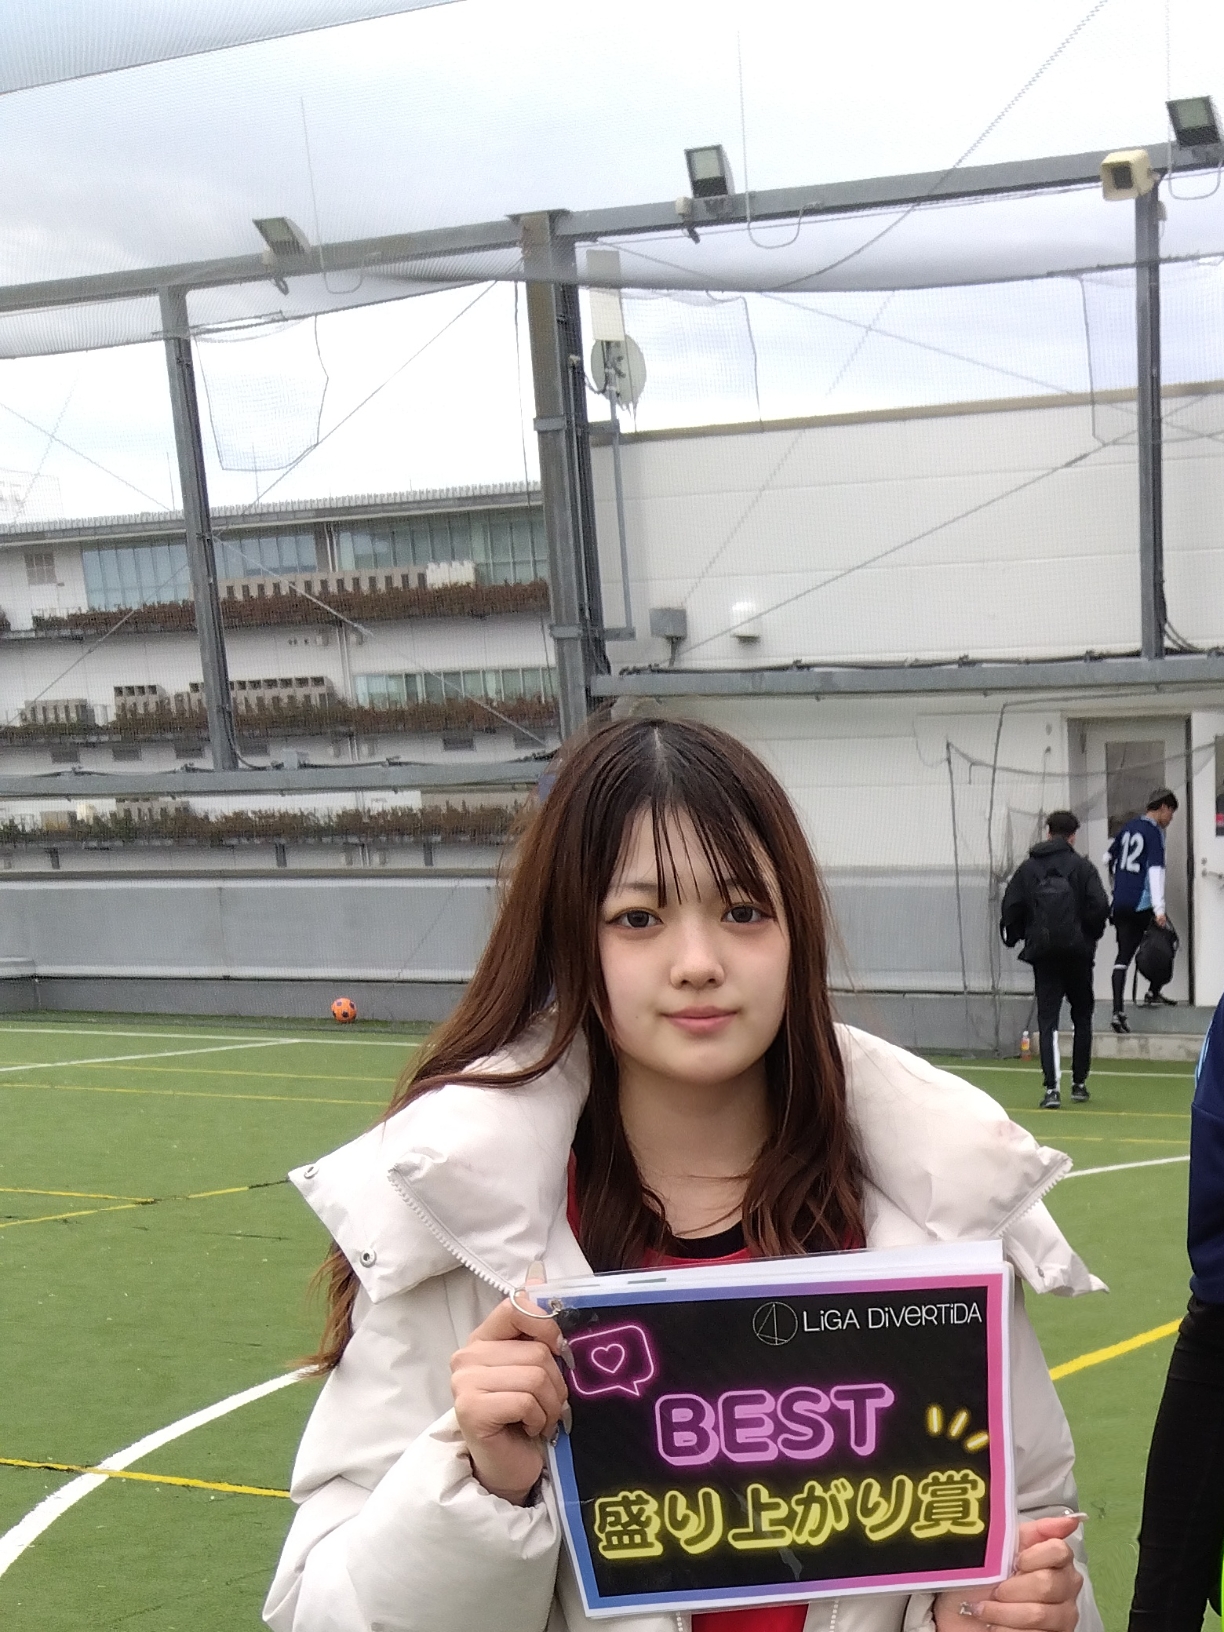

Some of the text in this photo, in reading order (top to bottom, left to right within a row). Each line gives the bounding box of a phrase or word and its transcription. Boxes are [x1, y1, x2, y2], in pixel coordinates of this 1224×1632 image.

[1120, 831, 1144, 873] 12
[655, 1382, 895, 1467] BEST
[595, 1469, 987, 1560] 盛り上がり賞
